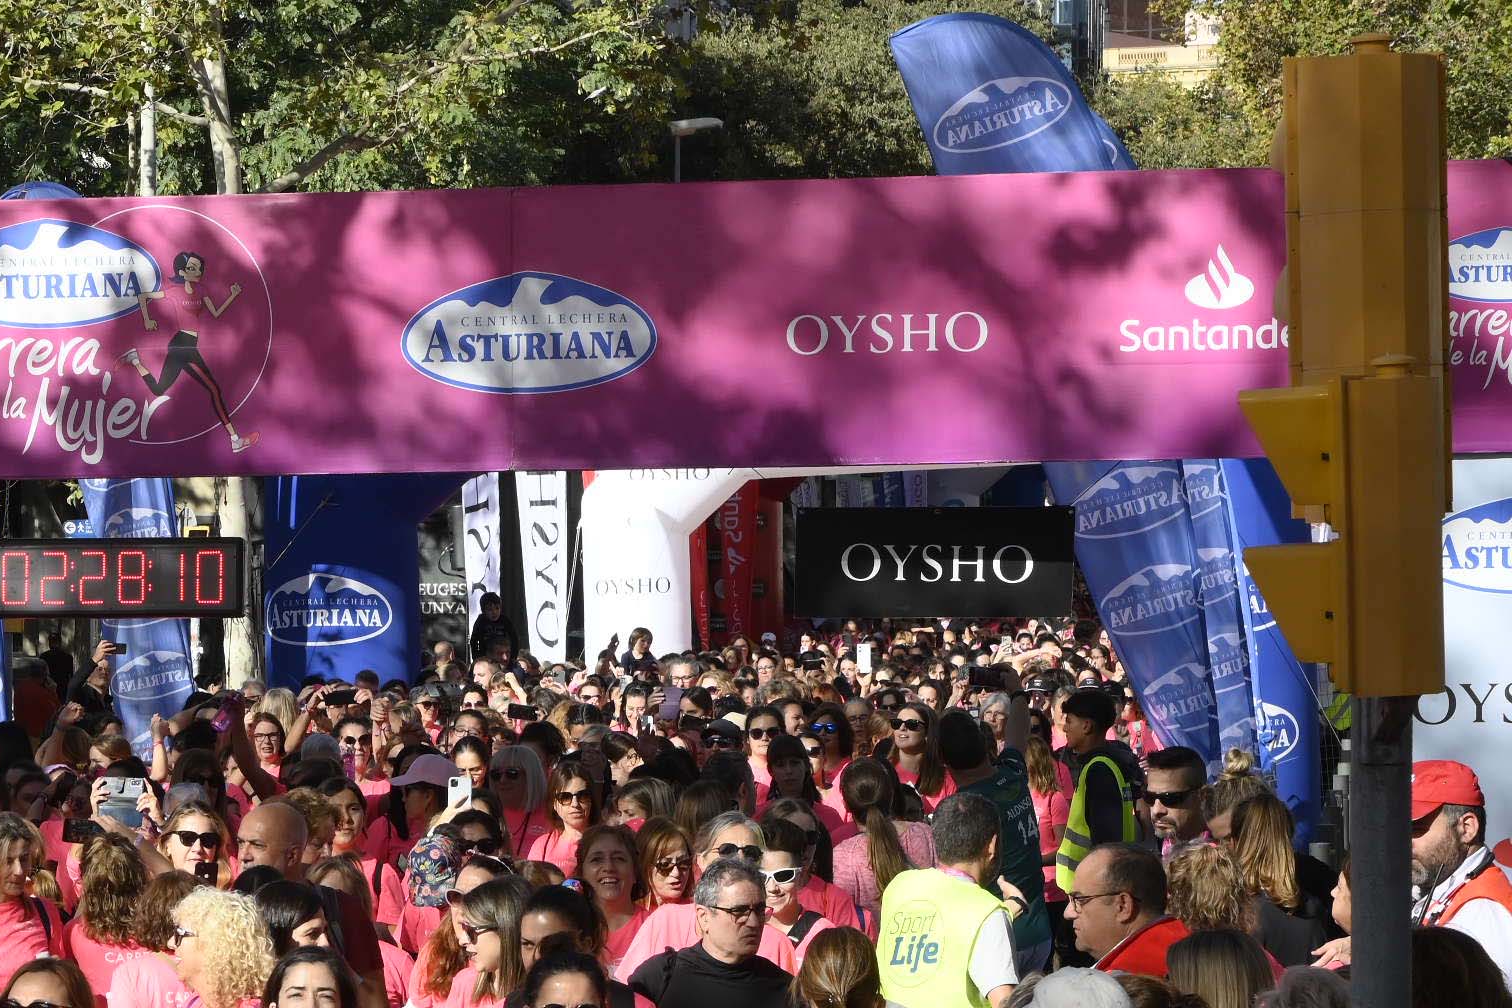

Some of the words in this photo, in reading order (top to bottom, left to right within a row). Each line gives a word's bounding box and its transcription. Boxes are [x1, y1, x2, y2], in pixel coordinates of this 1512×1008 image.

[461, 314, 539, 328] CENTRAL
[548, 312, 628, 325] LECHERA
[786, 311, 989, 356] OYSHO
[421, 319, 636, 364] ASTURIANA
[1470, 339, 1487, 366] la
[3, 381, 26, 419] la
[23, 373, 170, 465] Mujer
[2, 550, 224, 605] 02:28:10
[840, 543, 1035, 585] OYSHO
[595, 576, 672, 595] OYSHO
[270, 603, 383, 630] ASTURIANA
[889, 910, 937, 937] Sport
[889, 934, 940, 973] Life
